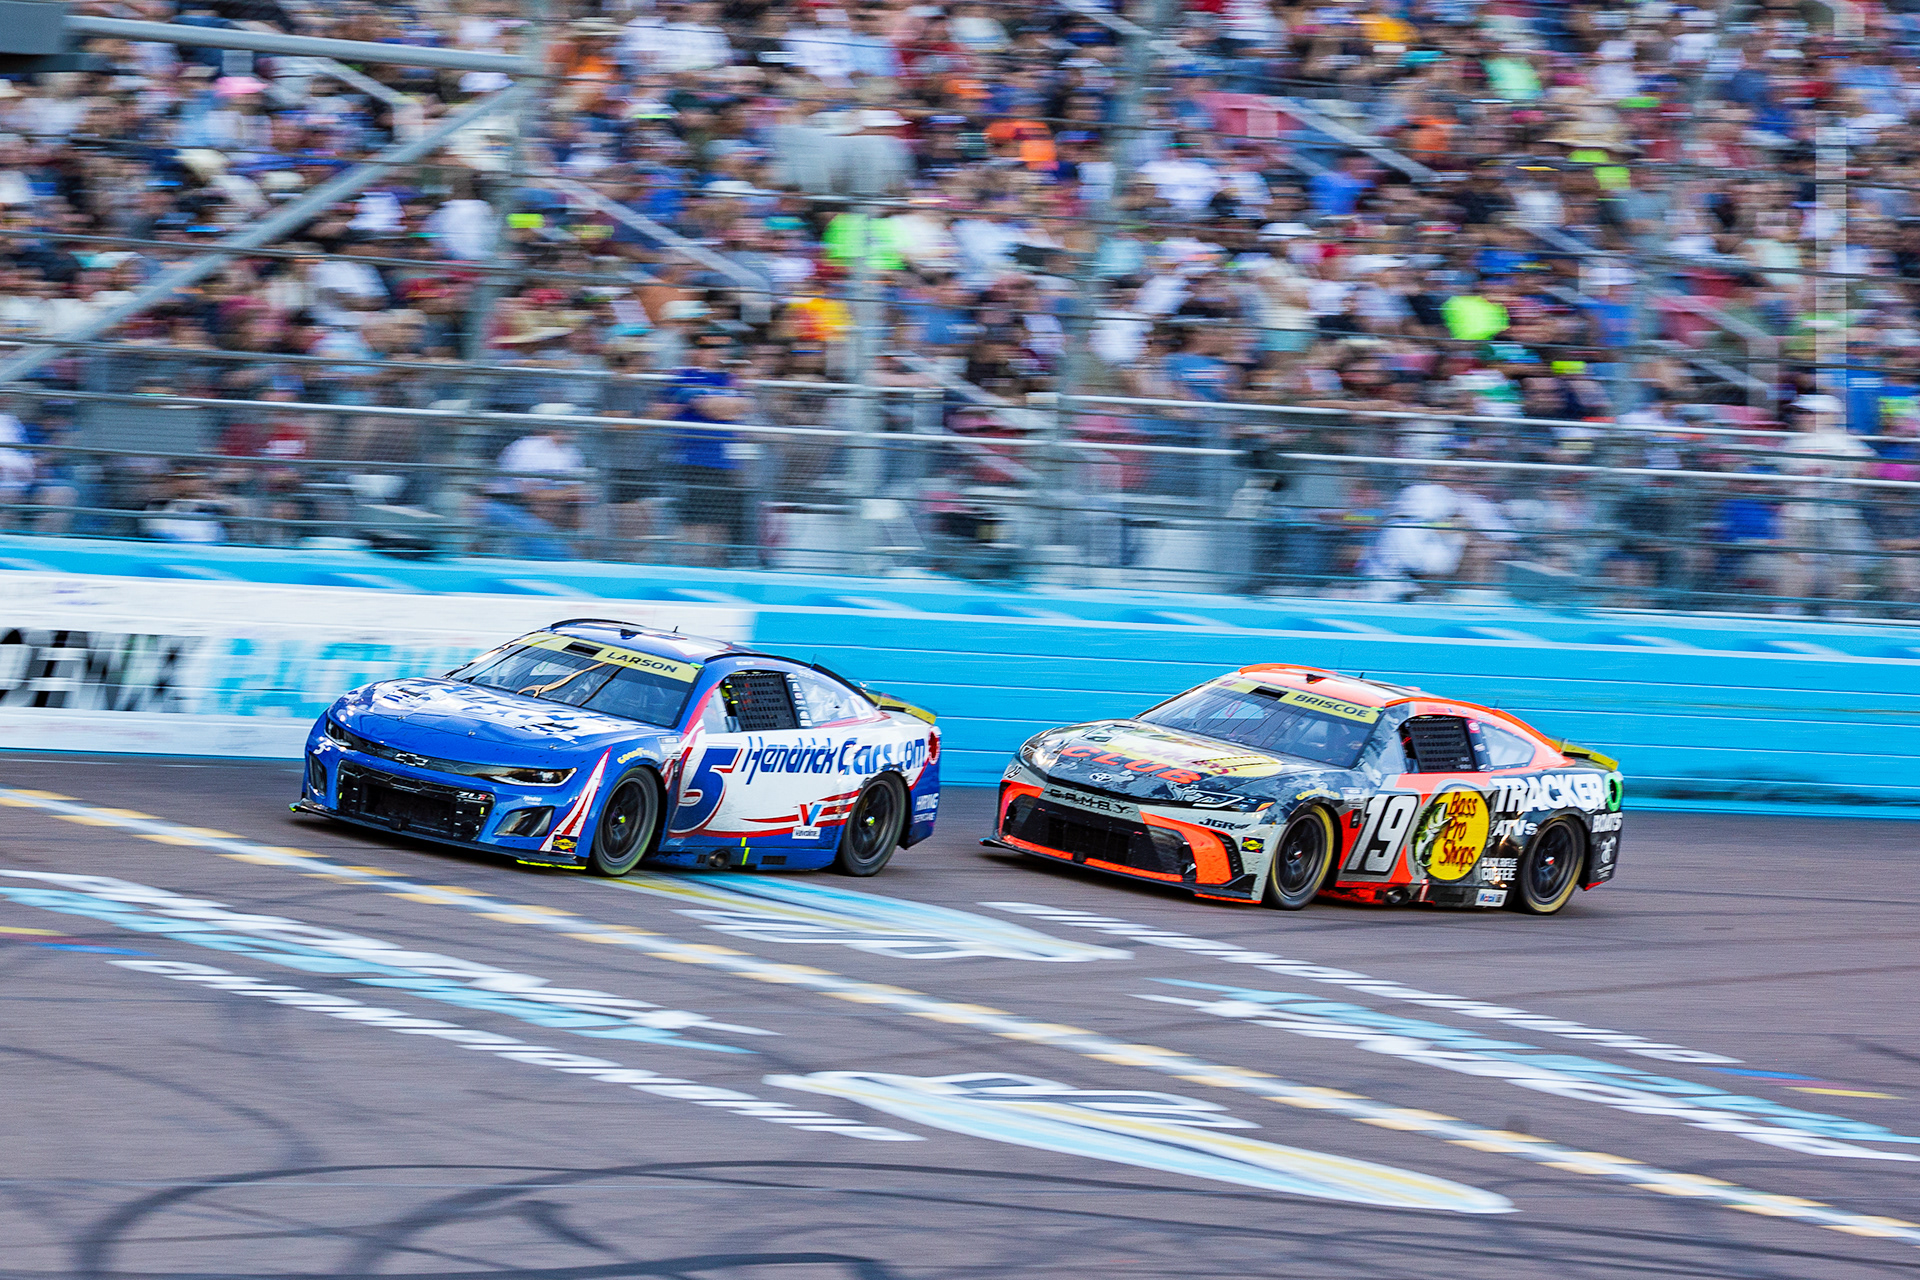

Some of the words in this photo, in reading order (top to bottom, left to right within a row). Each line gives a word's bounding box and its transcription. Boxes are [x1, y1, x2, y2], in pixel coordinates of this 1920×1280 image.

[606, 651, 678, 673] LARSON
[1293, 694, 1370, 718] BRISCOE
[1060, 745, 1203, 785] CLUB
[669, 745, 744, 837] 5
[1447, 791, 1478, 817] Bass
[1490, 773, 1607, 813] TRACKER
[1198, 817, 1236, 831] JGR
[1346, 793, 1419, 873] 19
[1444, 815, 1468, 841] Pro
[1438, 838, 1476, 872] Shops
